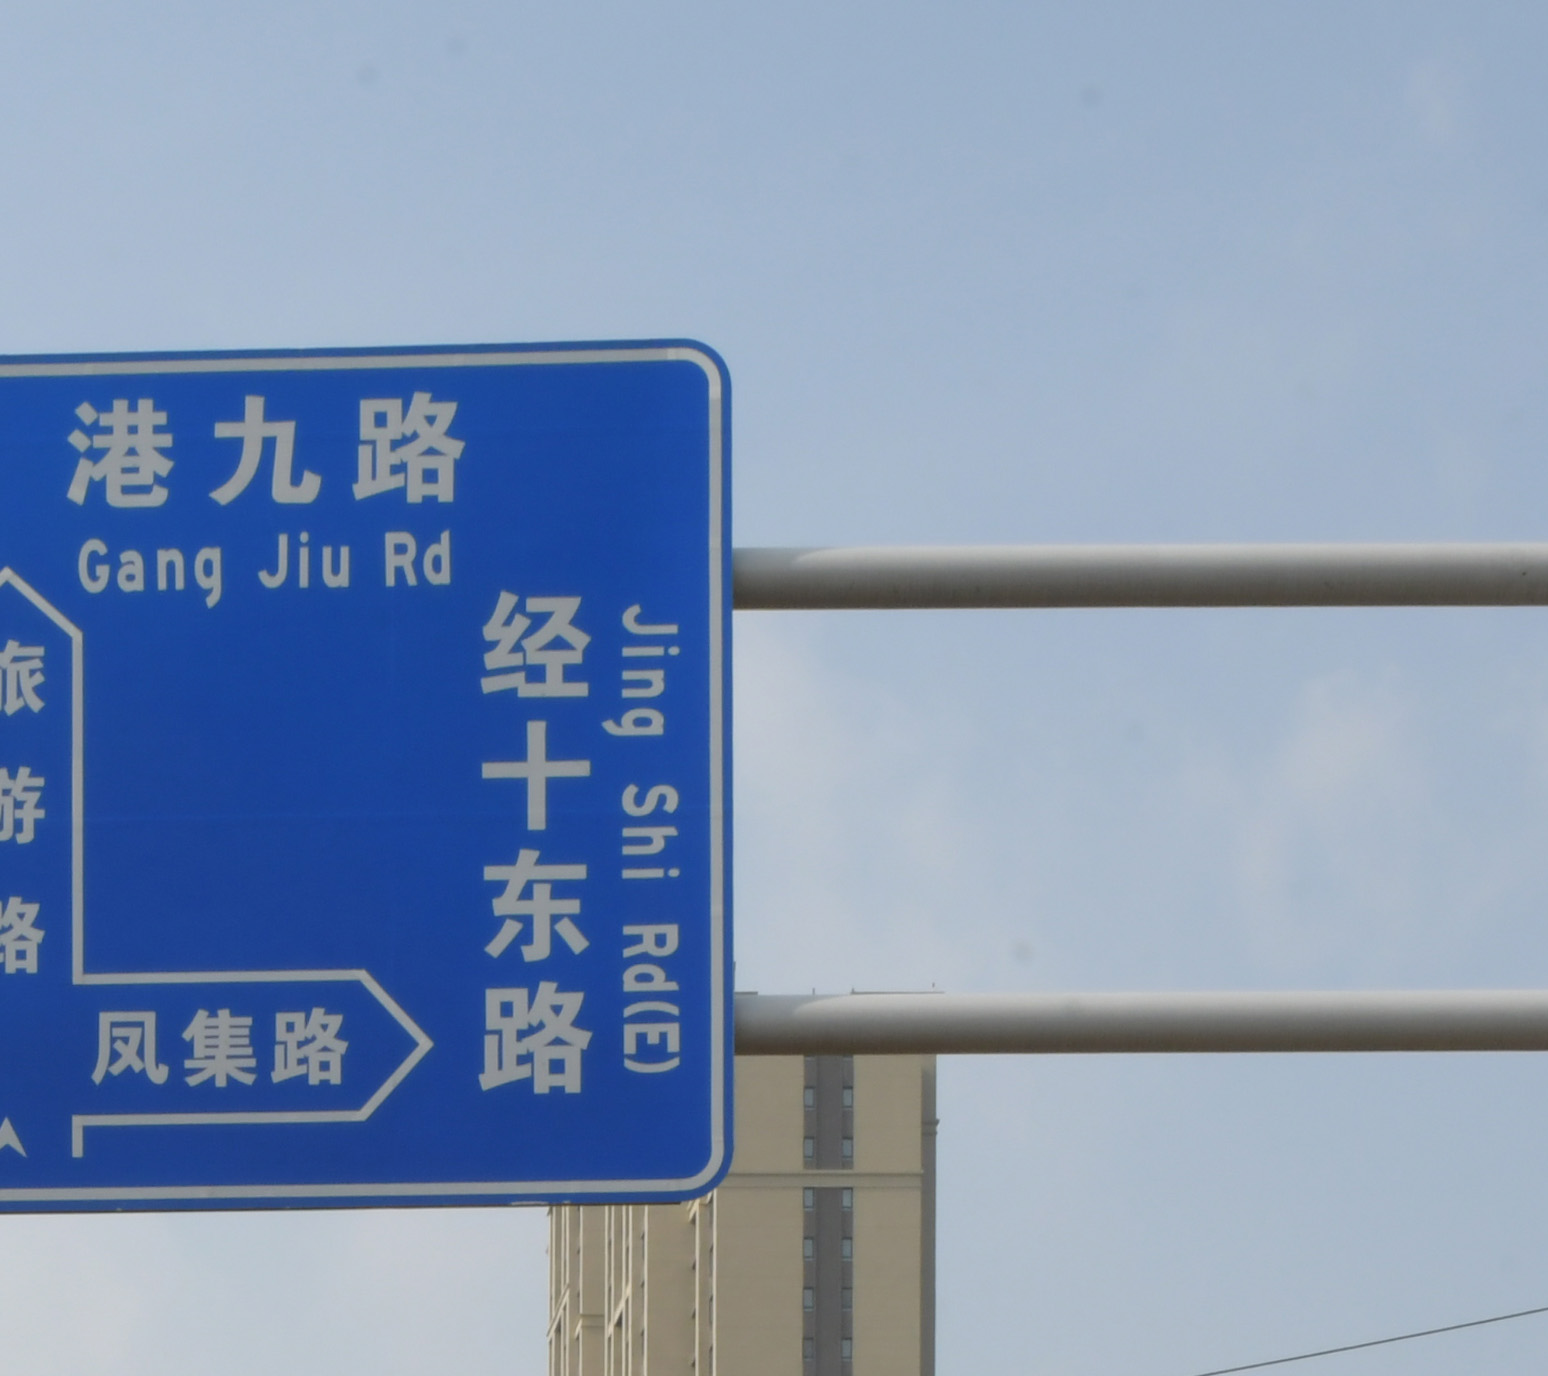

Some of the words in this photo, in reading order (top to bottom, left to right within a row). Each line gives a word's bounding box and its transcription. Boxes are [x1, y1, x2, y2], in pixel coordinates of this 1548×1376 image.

[66, 391, 466, 508] 港九路
[78, 534, 223, 609] Gang
[258, 530, 351, 589] Jiu
[384, 530, 452, 588] Rd
[602, 604, 681, 737] Jing
[478, 590, 593, 1095] 经十东路
[621, 783, 680, 880] Shi
[91, 1007, 350, 1088] 凤集路
[622, 923, 680, 1074] Rd(E)
